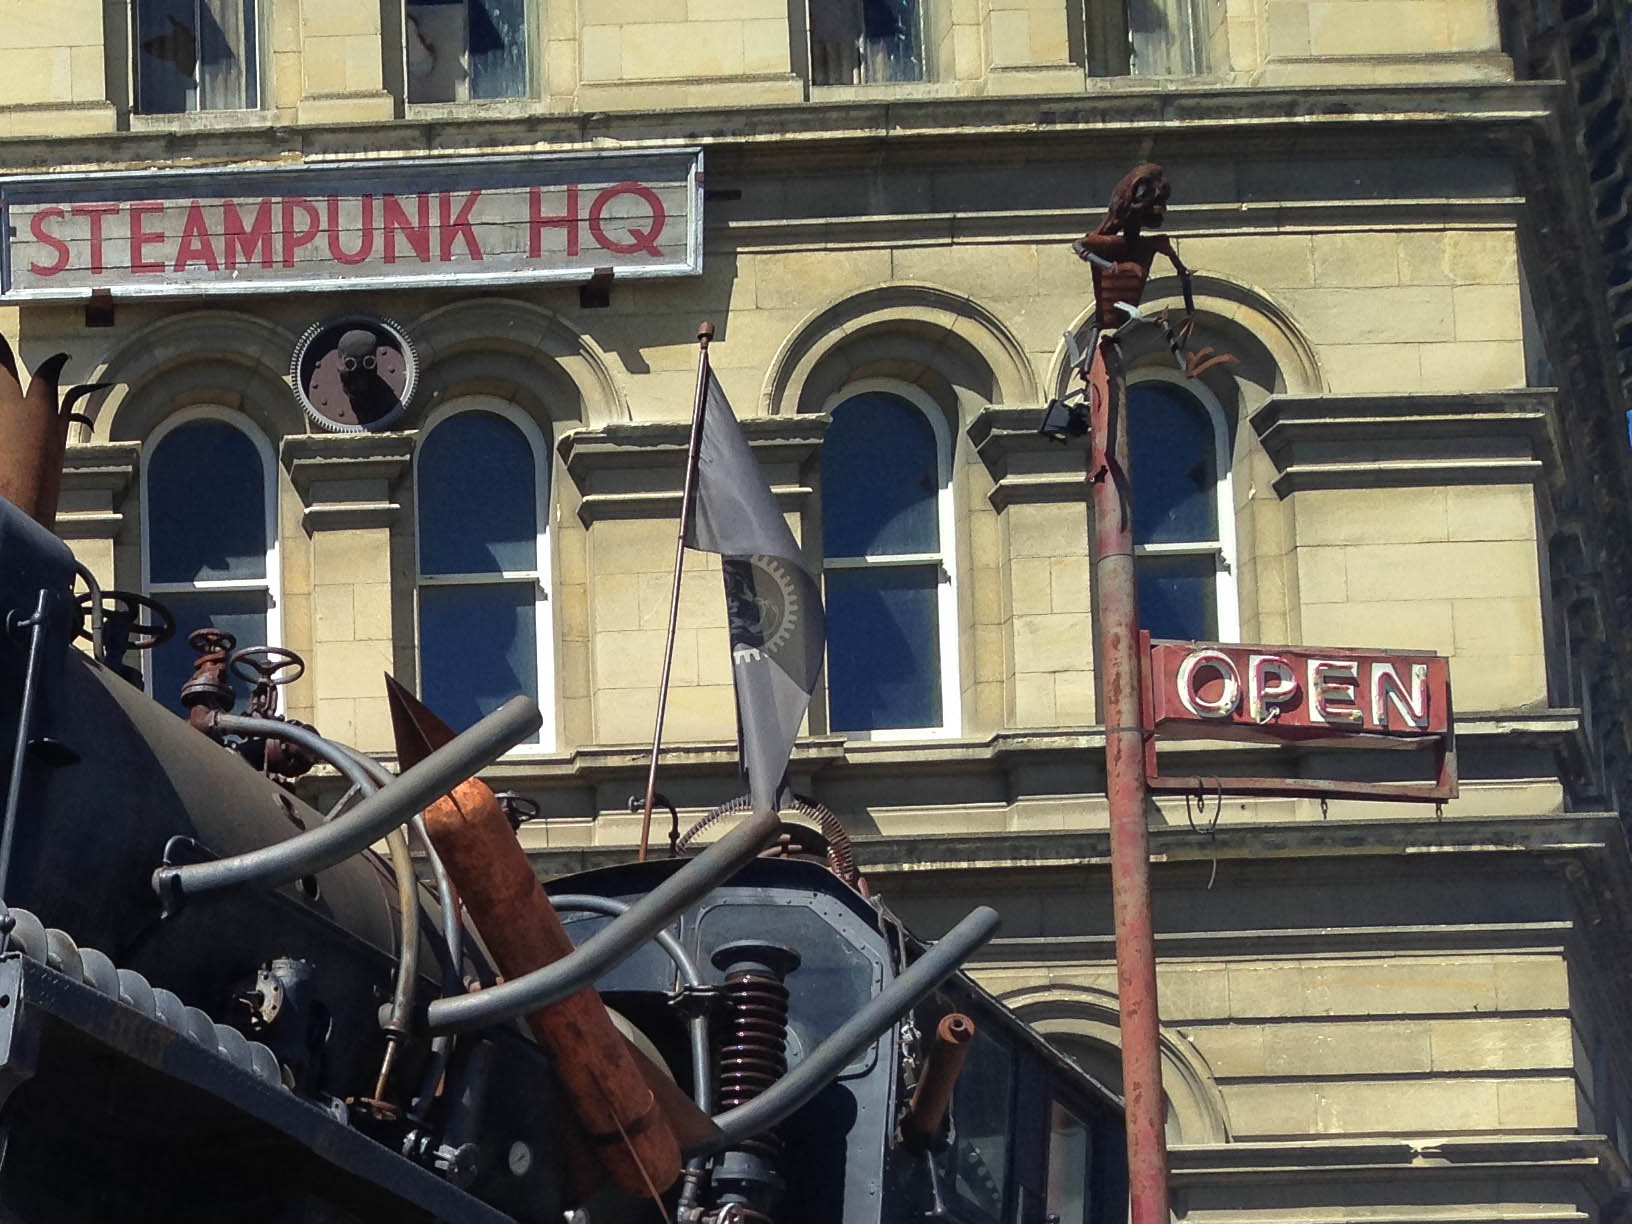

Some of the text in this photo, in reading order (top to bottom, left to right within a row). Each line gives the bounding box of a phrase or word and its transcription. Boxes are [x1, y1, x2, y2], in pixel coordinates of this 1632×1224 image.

[29, 180, 667, 277] STEAMPUNK HQ
[1176, 649, 1430, 728] OPEN
